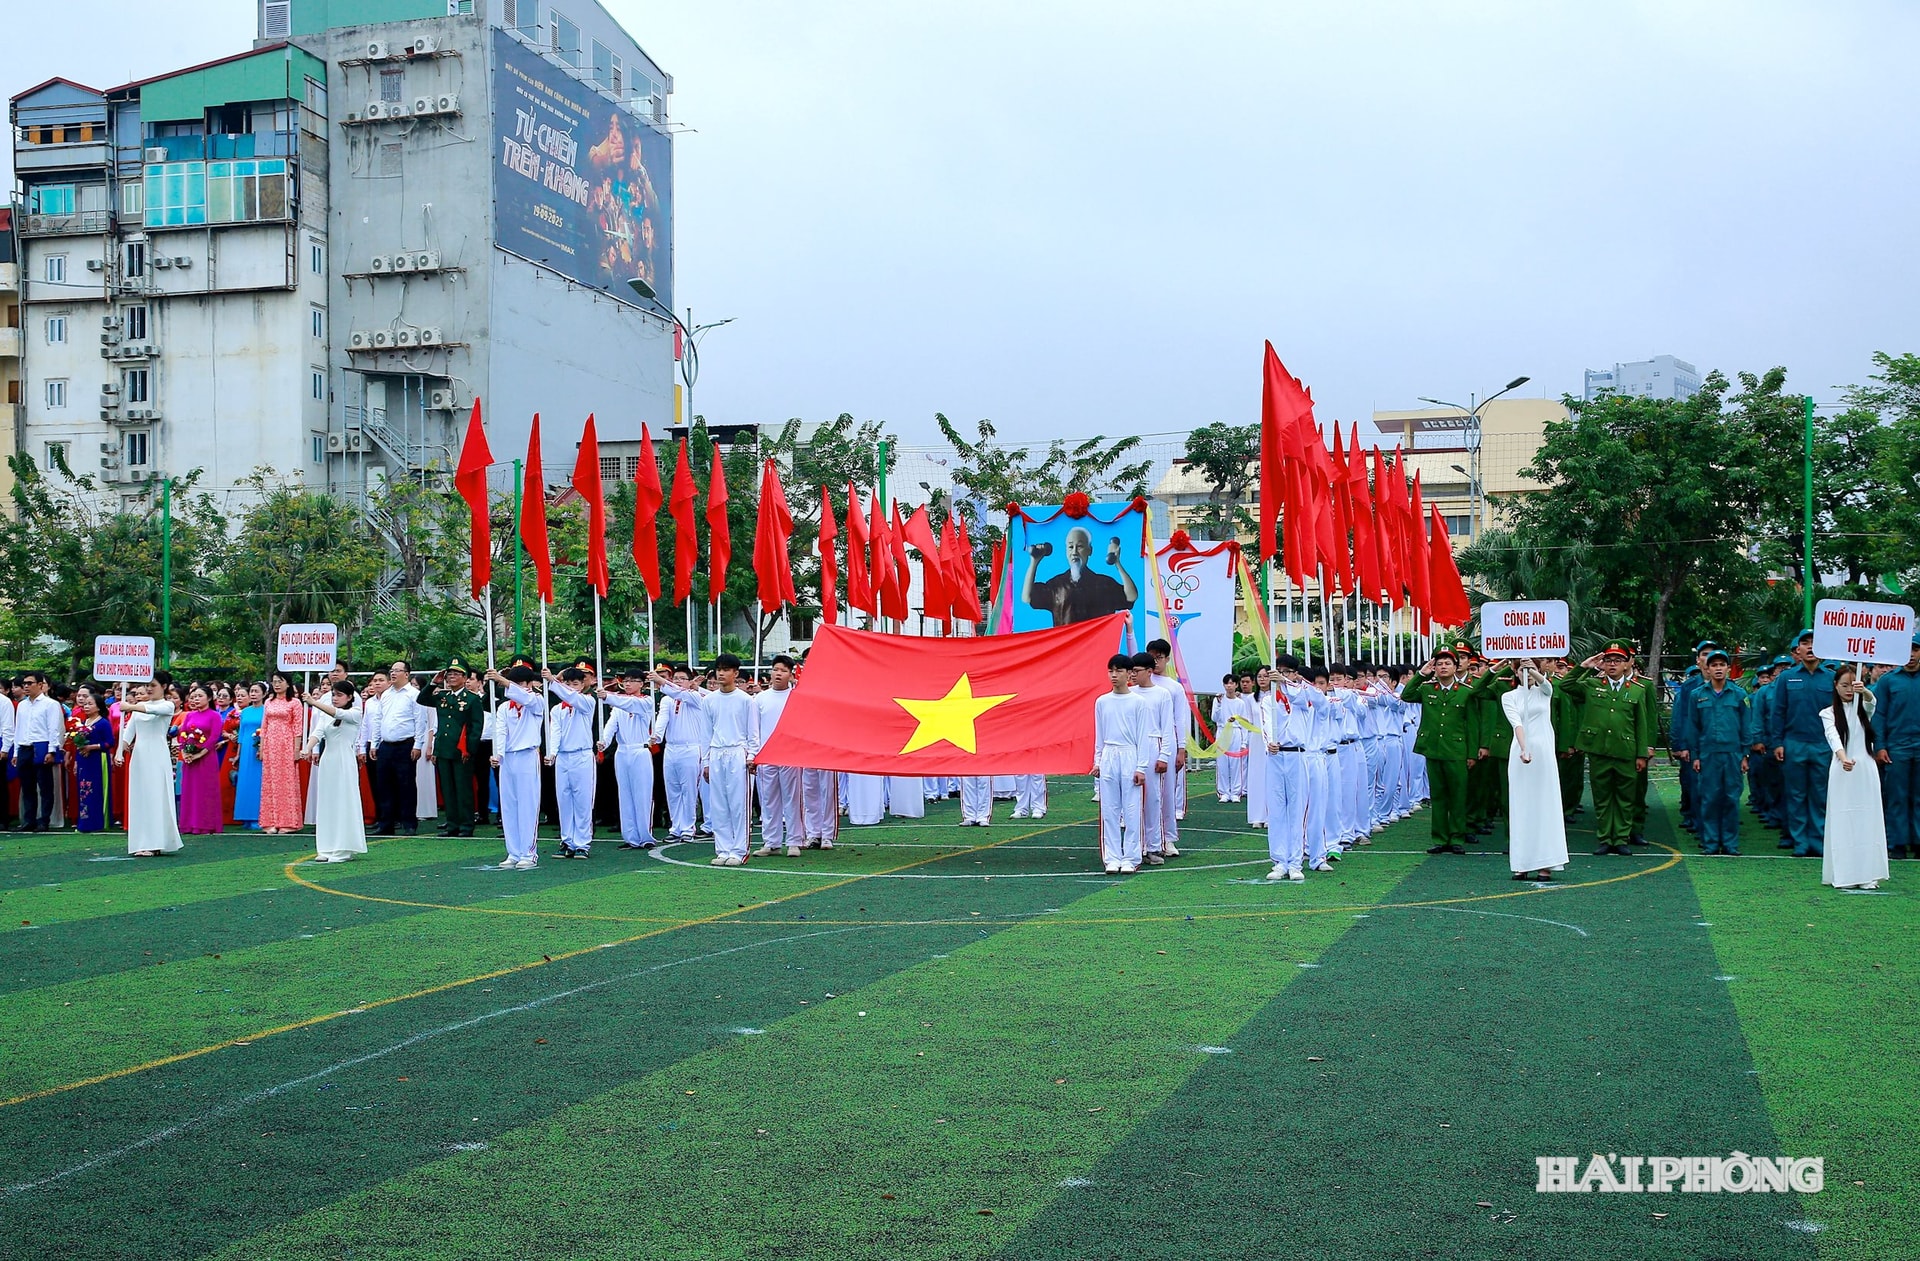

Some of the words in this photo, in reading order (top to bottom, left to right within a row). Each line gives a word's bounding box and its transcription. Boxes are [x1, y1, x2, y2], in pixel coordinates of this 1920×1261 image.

[1504, 609, 1530, 627] CÔNG
[1532, 611, 1546, 626] AN
[1823, 607, 1848, 627] KHỐI
[1850, 610, 1873, 629] DÂN
[1875, 613, 1905, 631] QUÂN
[281, 630, 290, 647] HỘI
[303, 629, 320, 645] CHIẾN
[1486, 633, 1523, 651] PHƯỜNG
[1526, 633, 1537, 650] LÊ
[1540, 632, 1565, 650] CHÂN
[1847, 638, 1861, 656] TỰ
[1863, 637, 1876, 658] VỆ
[283, 650, 306, 665] PHƯỜNG
[307, 650, 314, 664] LÊ
[315, 650, 331, 664] CHÂN
